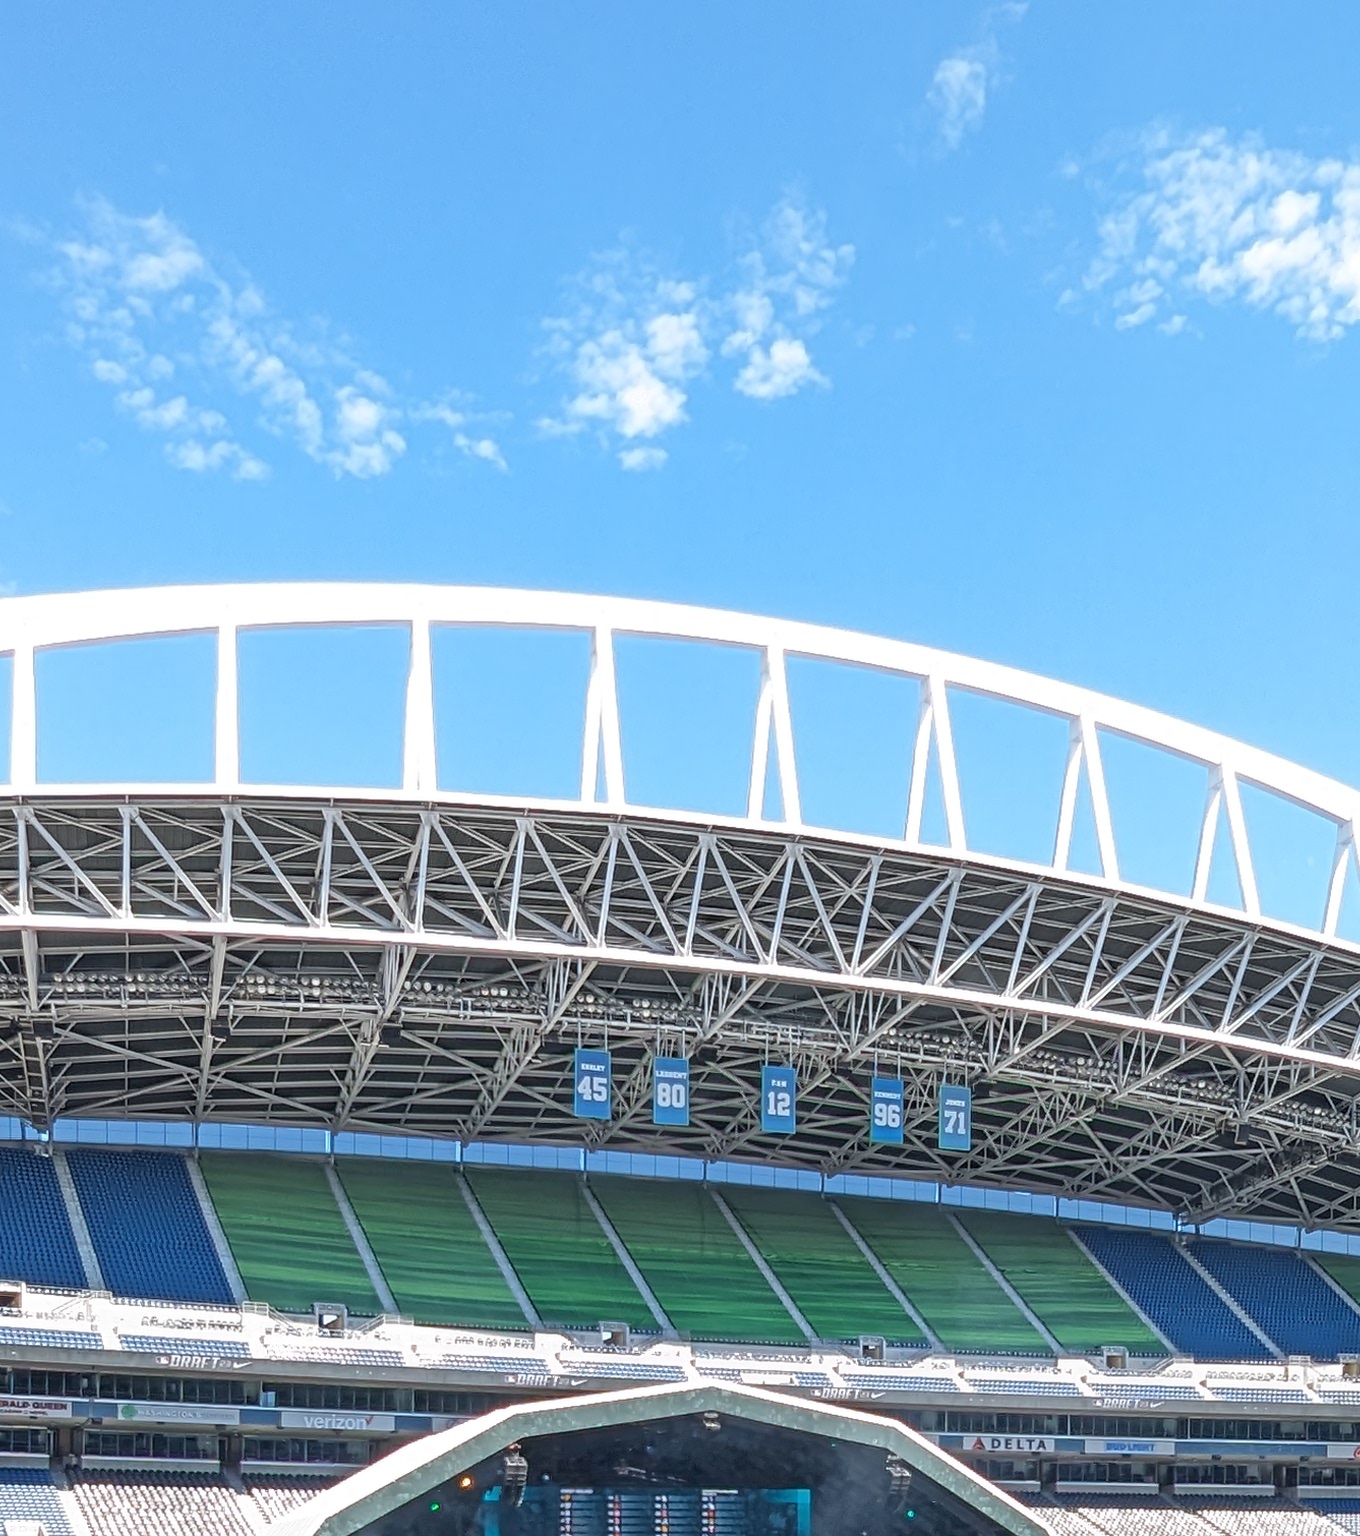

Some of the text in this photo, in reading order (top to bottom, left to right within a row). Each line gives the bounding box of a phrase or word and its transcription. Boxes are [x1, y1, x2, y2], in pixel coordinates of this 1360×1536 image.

[577, 1076, 608, 1101] 45
[656, 1083, 685, 1108] 80
[767, 1091, 790, 1117] 12
[874, 1103, 900, 1128] 96
[944, 1110, 966, 1134] 71
[170, 1355, 221, 1368] DRAFT
[517, 1374, 559, 1386] DRAFT
[821, 1388, 862, 1399] DRAFT
[30, 1402, 68, 1411] QUEEN
[303, 1414, 367, 1430] verizon
[990, 1438, 1048, 1451] DELTA
